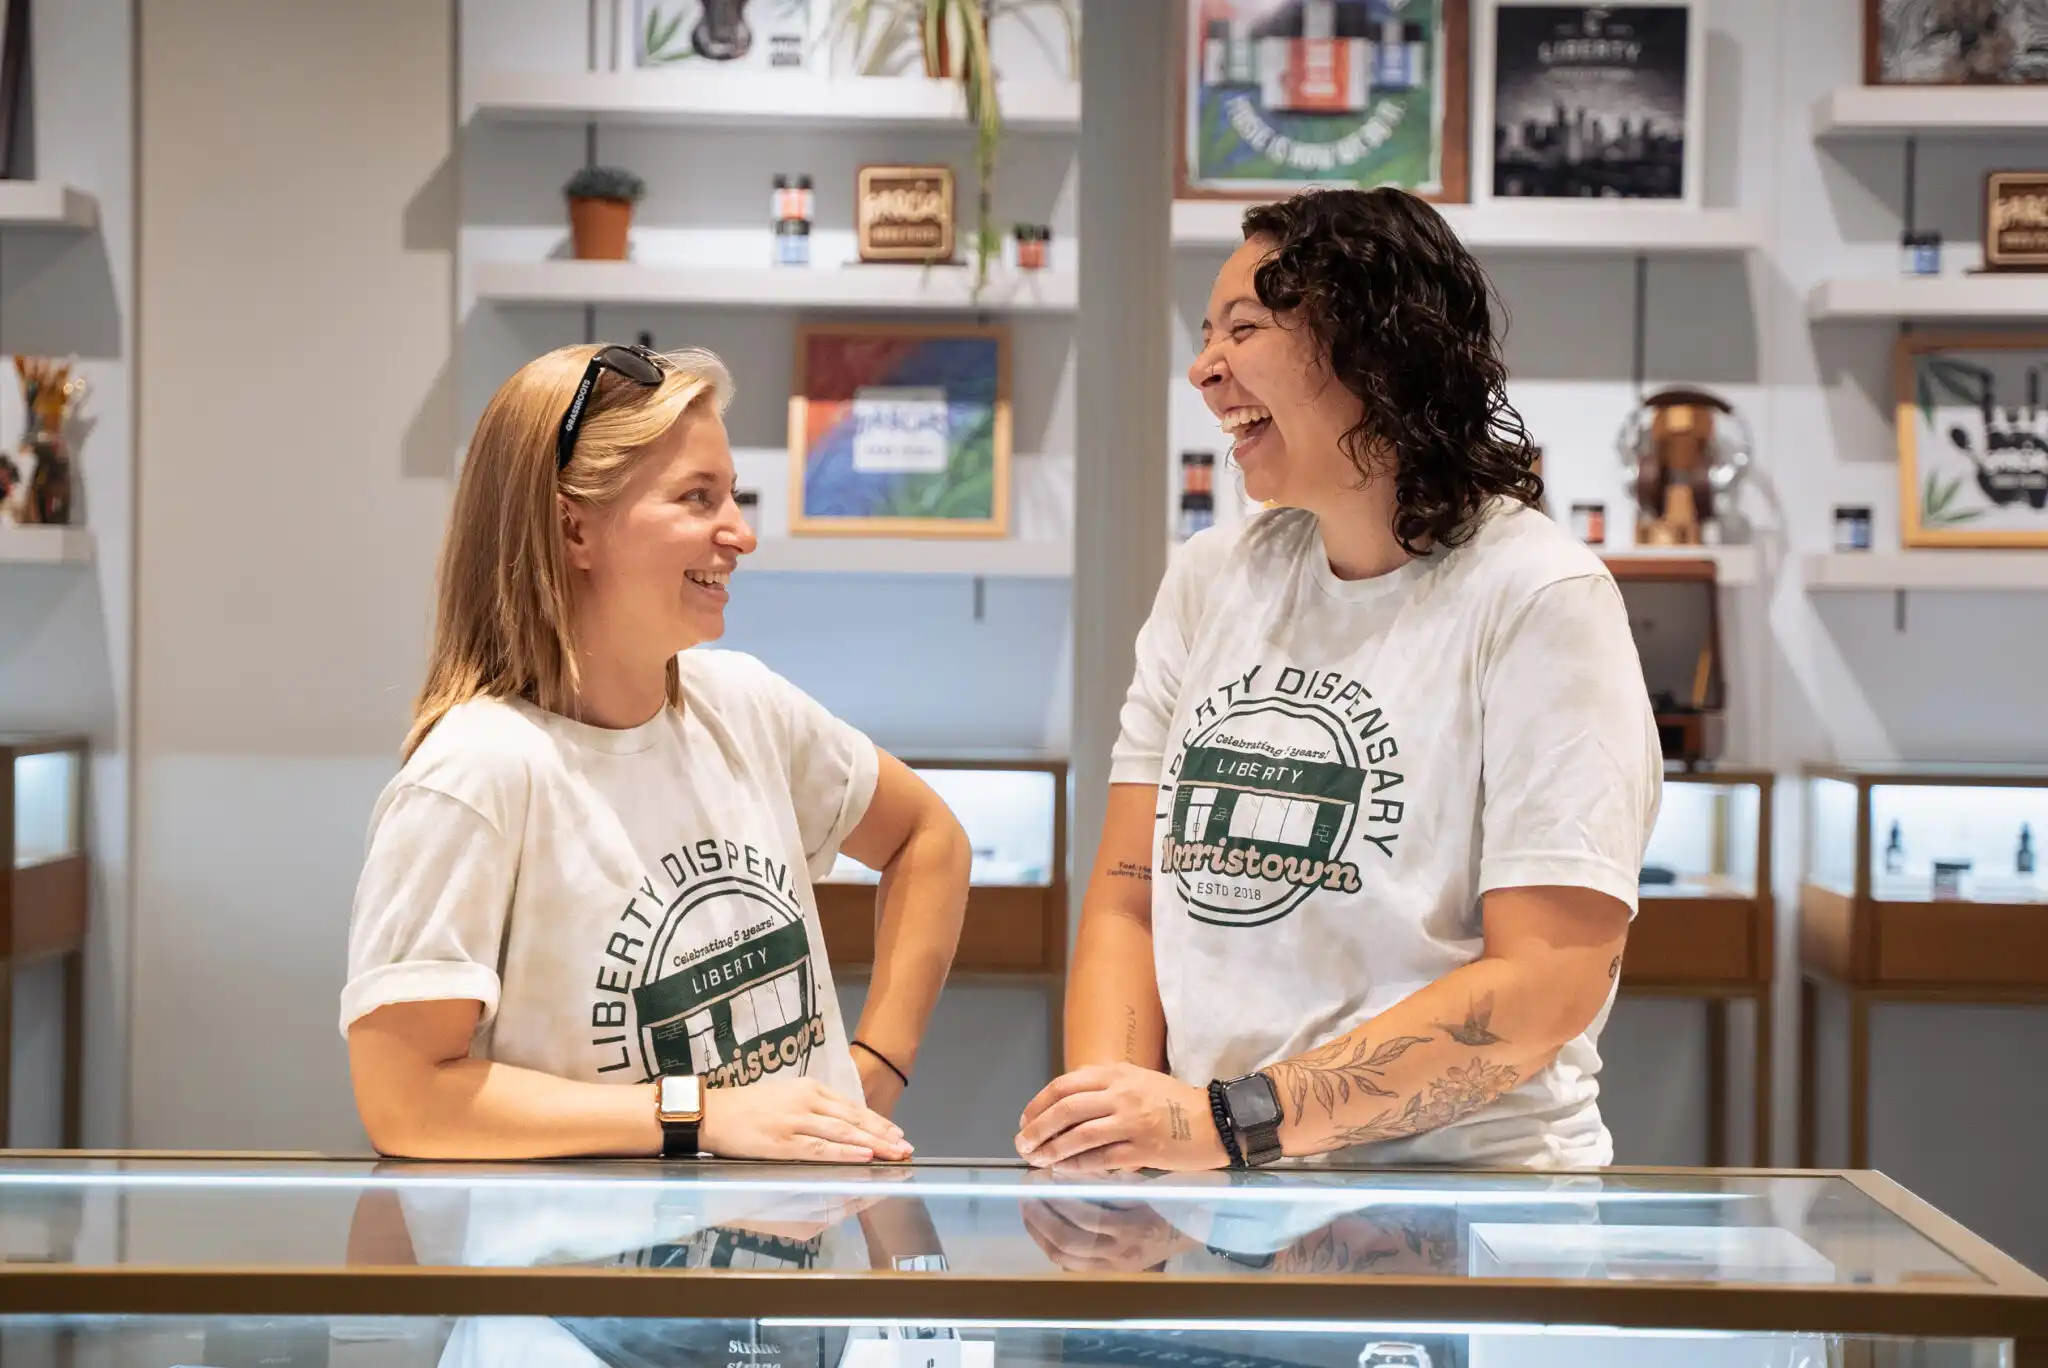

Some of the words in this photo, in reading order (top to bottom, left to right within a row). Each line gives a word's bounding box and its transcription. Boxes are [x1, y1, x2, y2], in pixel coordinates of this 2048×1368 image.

[565, 379, 591, 431] GRASSROOTS
[1215, 734, 1285, 757] Celebrating
[1216, 758, 1304, 784] LIBERTY
[1275, 667, 1405, 859] DISPENSARY
[1161, 836, 1363, 894] Norristown
[1196, 881, 1229, 897] ESTD
[1233, 886, 1262, 901] 2018
[672, 934, 734, 967] Celebrating
[733, 930, 740, 942] 5
[740, 915, 776, 941] years!
[592, 876, 664, 1073] LIBERTY
[691, 946, 769, 995] LIBERTY
